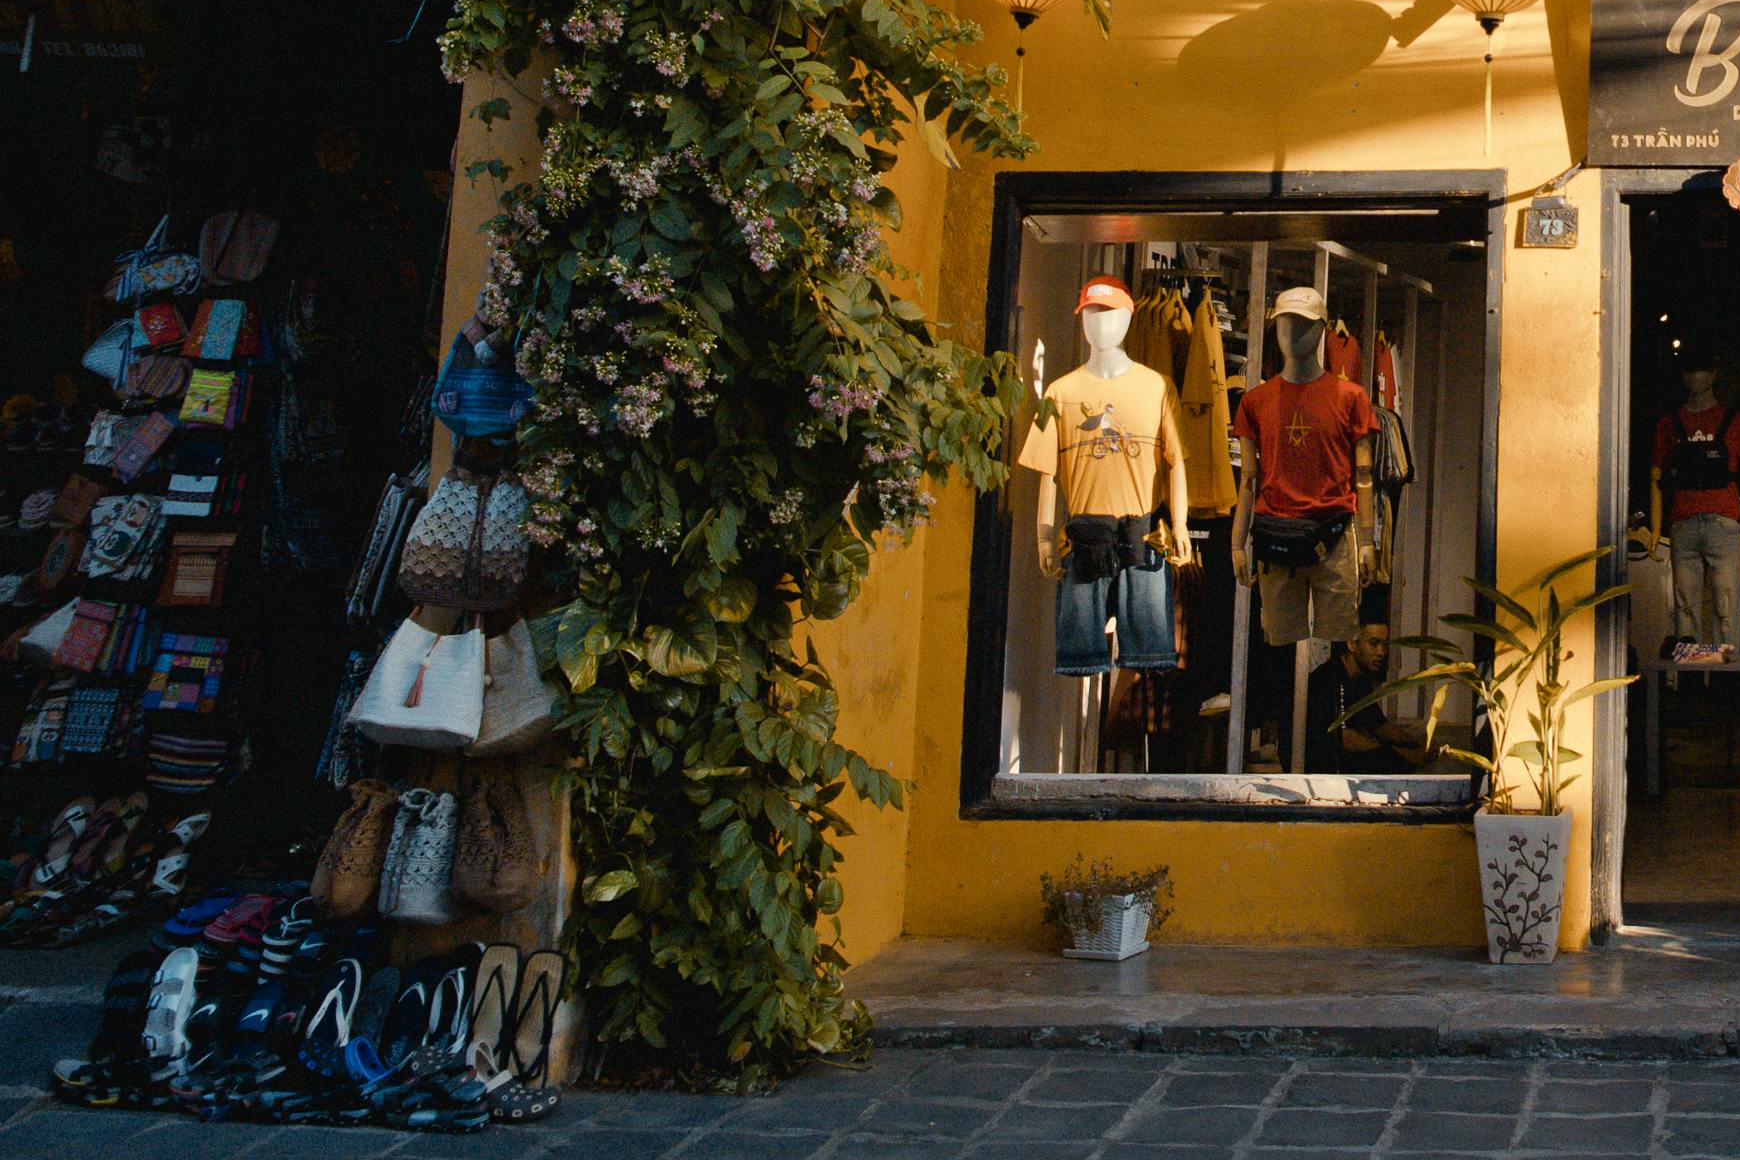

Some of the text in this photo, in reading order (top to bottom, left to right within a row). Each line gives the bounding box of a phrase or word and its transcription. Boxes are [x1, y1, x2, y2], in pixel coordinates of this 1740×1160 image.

[1632, 126, 1683, 149] TRẦN
[1685, 128, 1720, 149] PHÚ
[1539, 218, 1564, 236] 73
